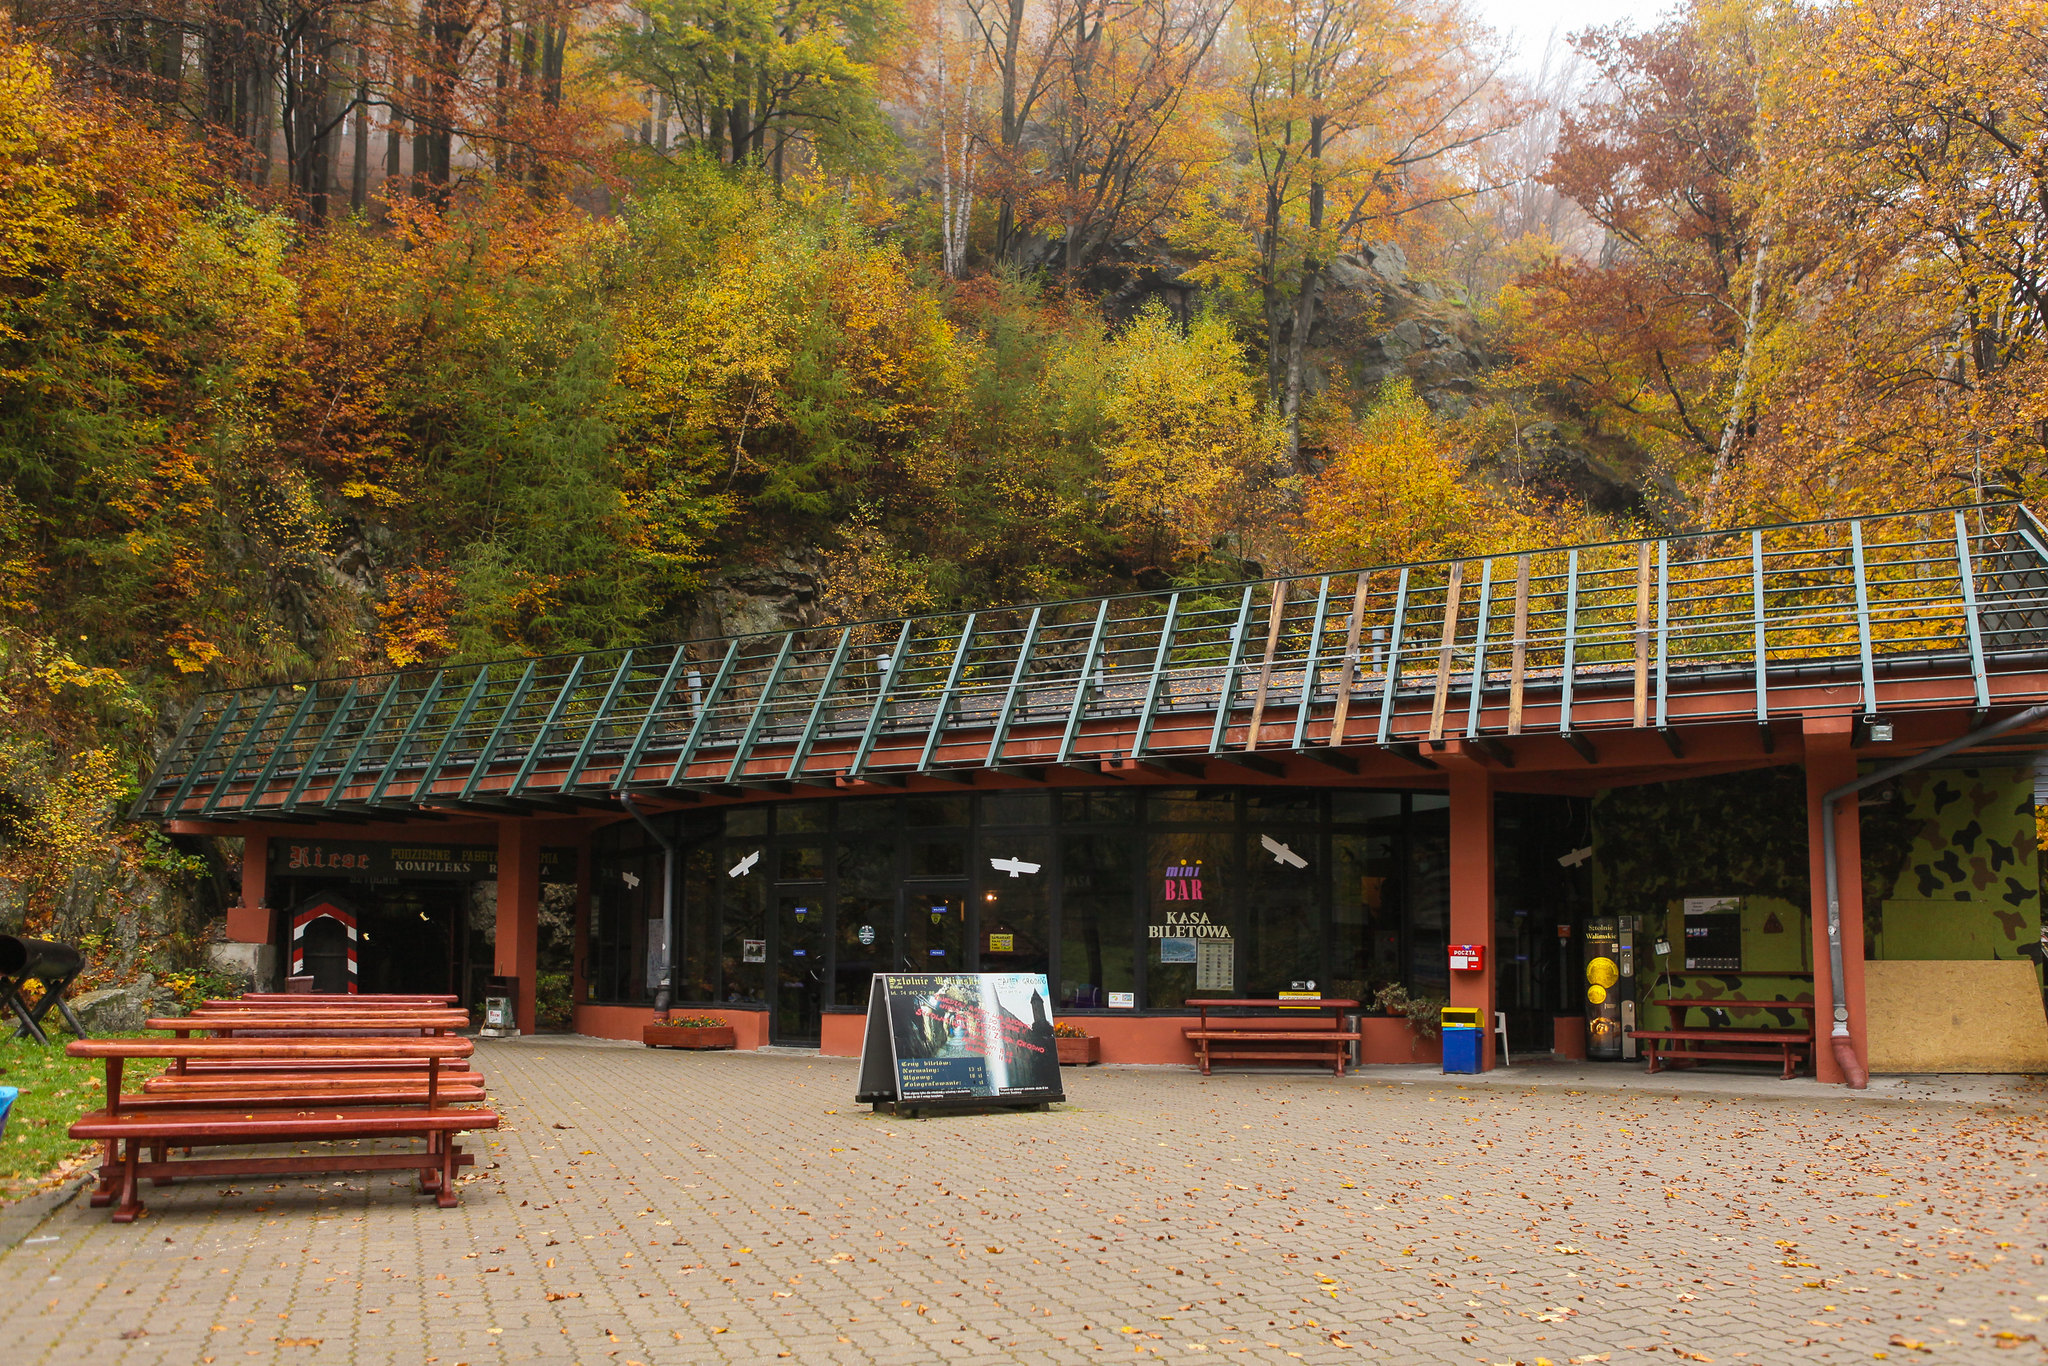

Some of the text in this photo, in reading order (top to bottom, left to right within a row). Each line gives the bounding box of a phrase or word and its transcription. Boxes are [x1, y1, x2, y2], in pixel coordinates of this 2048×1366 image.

[289, 846, 370, 870] Riese
[391, 848, 499, 863] PODZIEMNE FABRY
[395, 860, 471, 874] KOMPLEKS
[1165, 859, 1203, 877] mini
[1165, 879, 1204, 901] BAR
[1166, 912, 1211, 925] KASA
[1148, 925, 1232, 938] BILETOWA
